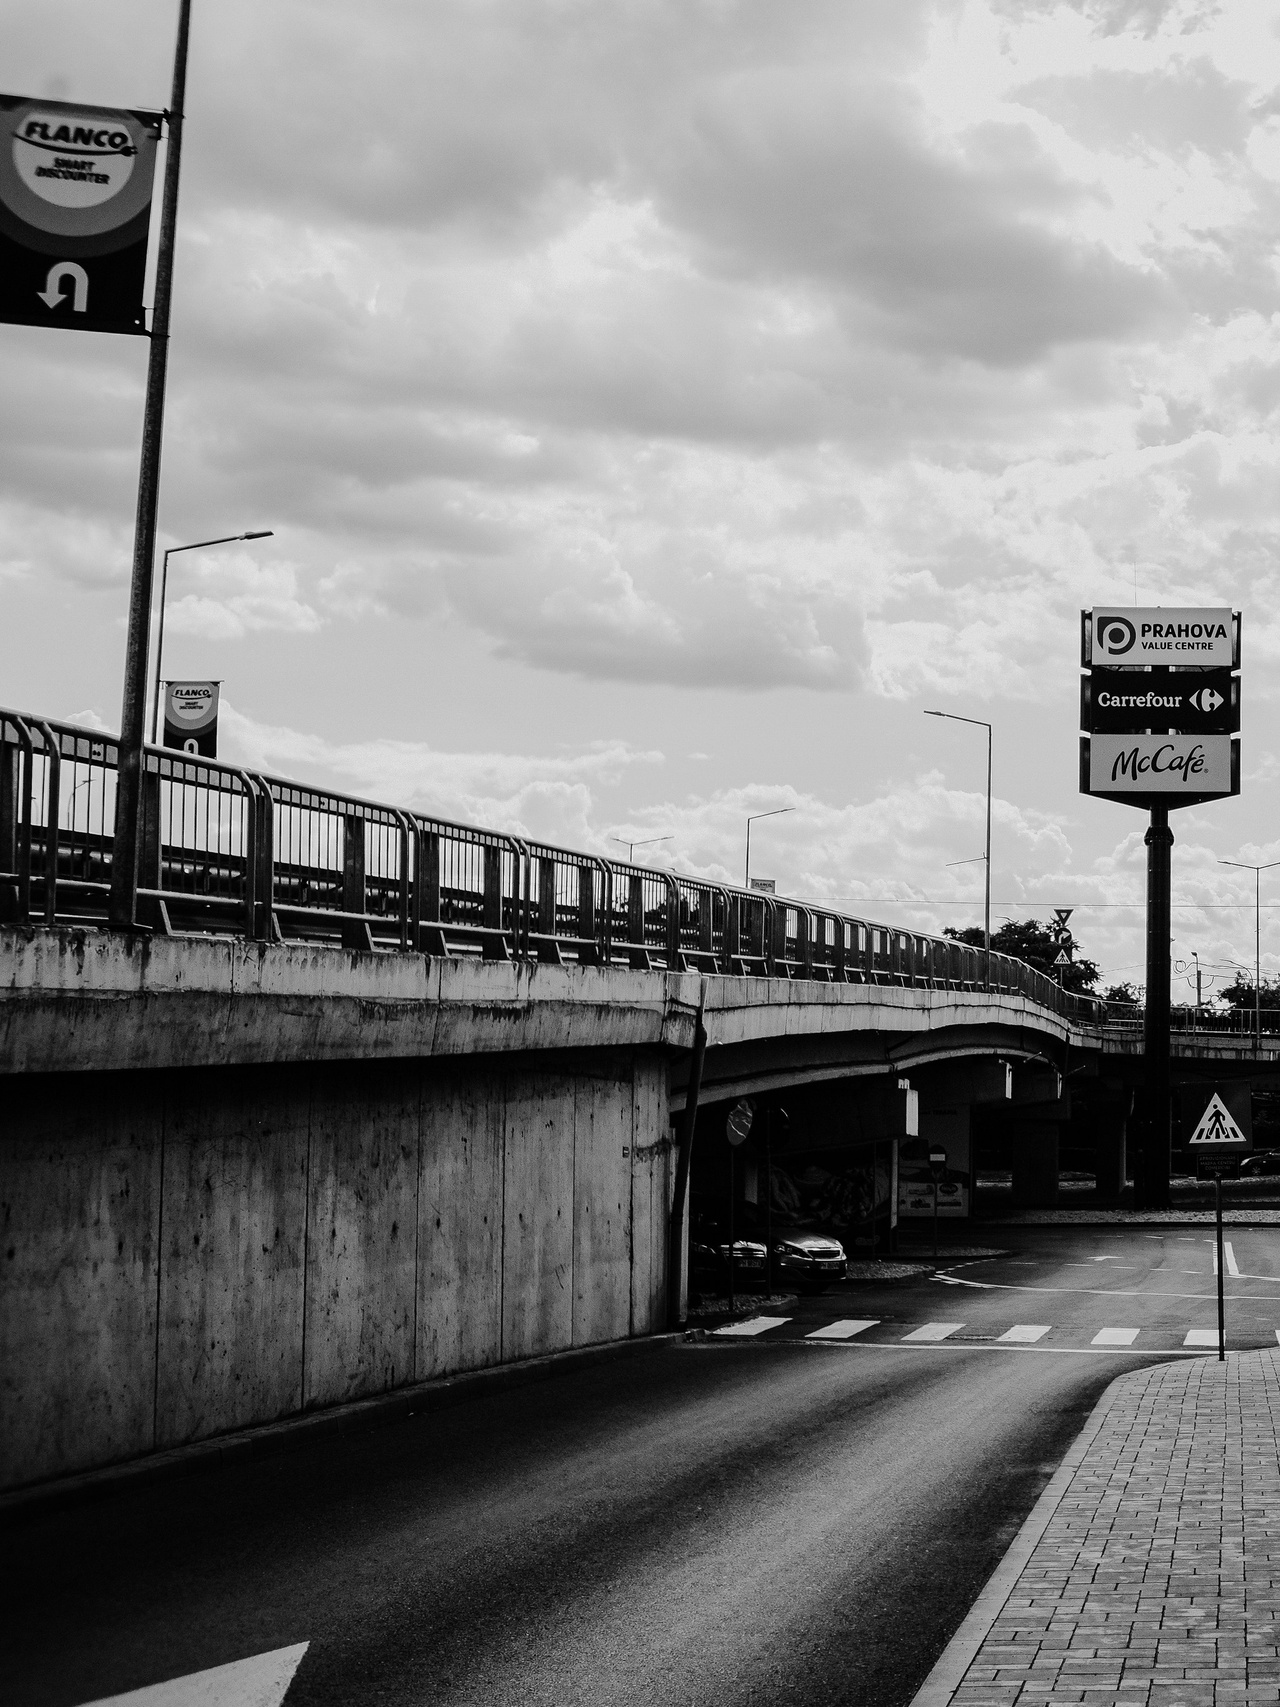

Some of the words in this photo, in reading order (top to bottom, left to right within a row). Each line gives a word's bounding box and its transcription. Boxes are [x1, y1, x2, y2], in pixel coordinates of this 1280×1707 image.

[25, 121, 128, 149] FLANCO
[54, 157, 95, 172] SMART
[35, 167, 110, 185] DISCOUNTER
[1141, 623, 1227, 639] PRAHOVA
[1141, 641, 1173, 650] VALUE
[1175, 641, 1214, 651] CENTRE
[1097, 691, 1182, 708] Carrefour
[1111, 744, 1206, 782] McCafé
